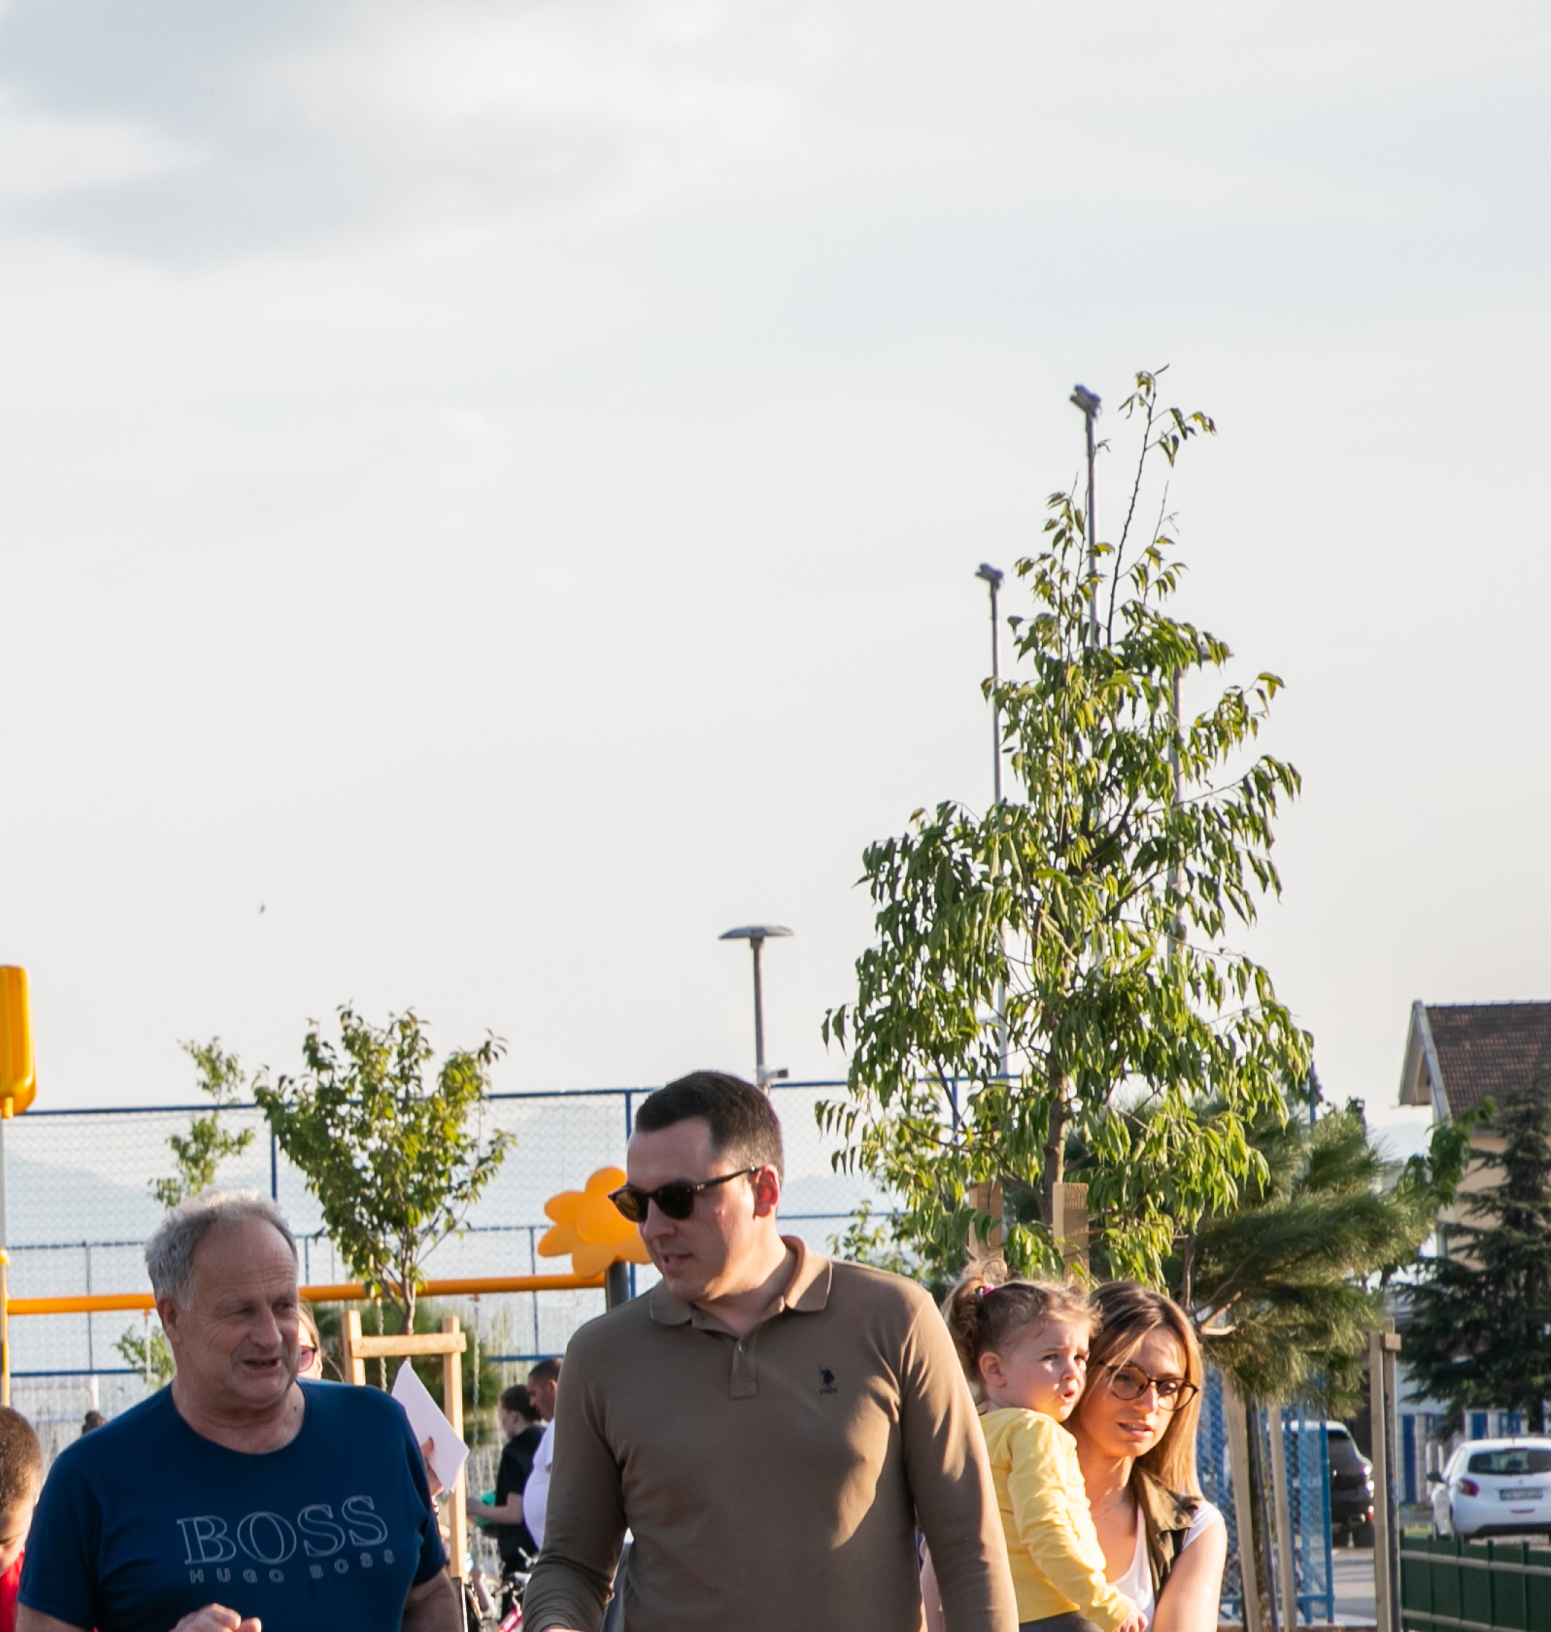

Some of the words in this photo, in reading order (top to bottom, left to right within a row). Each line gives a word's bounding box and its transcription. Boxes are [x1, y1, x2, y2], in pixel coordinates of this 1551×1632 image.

[176, 1495, 389, 1564] BOSS
[189, 1567, 284, 1584] HUGO
[309, 1549, 395, 1580] BOSS
